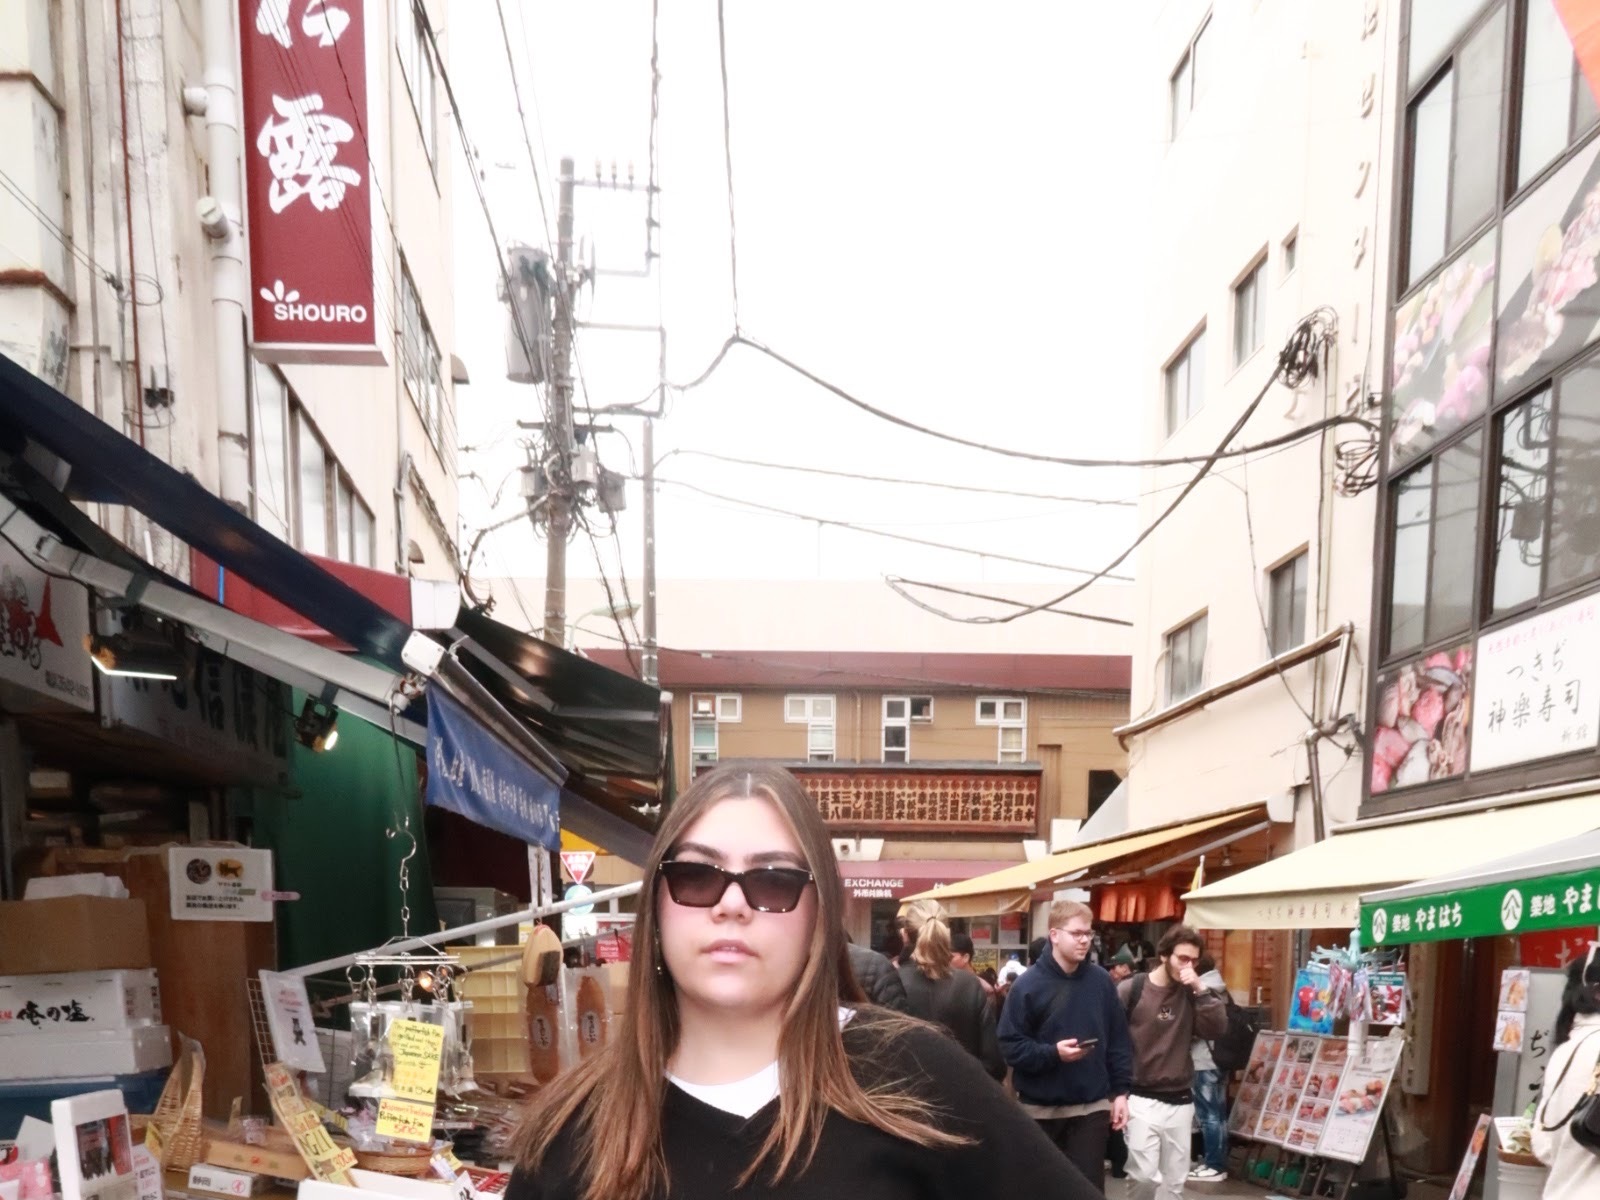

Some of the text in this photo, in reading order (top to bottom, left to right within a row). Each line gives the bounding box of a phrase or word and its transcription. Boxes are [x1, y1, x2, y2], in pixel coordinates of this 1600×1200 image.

[274, 304, 367, 322] SHOURO
[1507, 638, 1568, 681] つきぢ
[1488, 679, 1581, 734] 神楽寿司
[844, 879, 904, 888] EXCHANGE
[1392, 902, 1462, 933] 築地 やまはち
[1530, 894, 1556, 917] 築地
